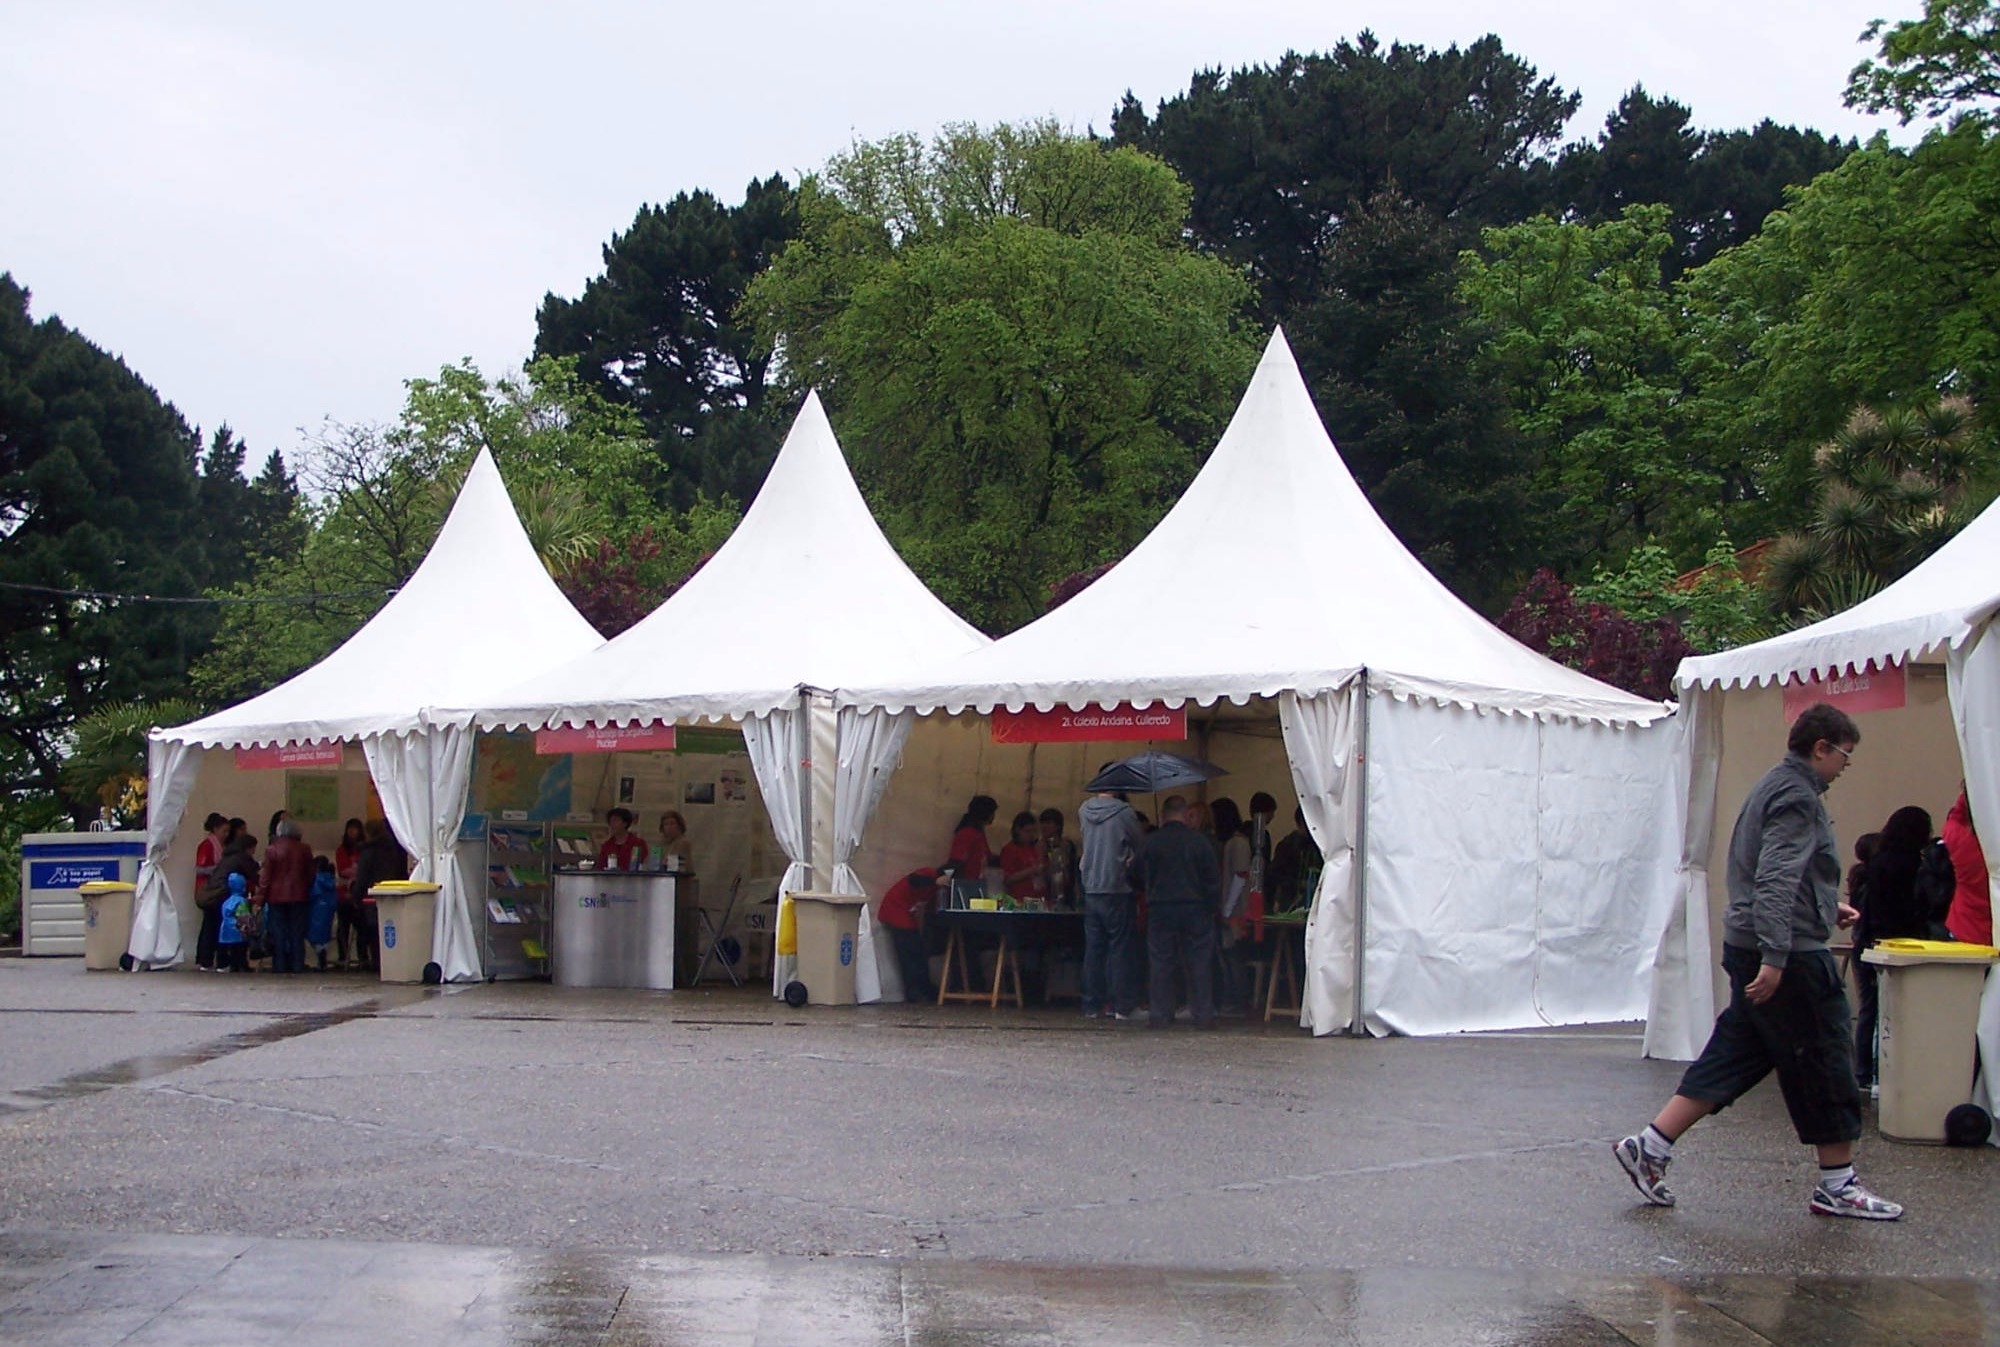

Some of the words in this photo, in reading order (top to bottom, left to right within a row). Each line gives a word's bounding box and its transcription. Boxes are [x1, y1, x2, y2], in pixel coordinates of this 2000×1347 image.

[1073, 716, 1099, 727] Colexio
[1135, 714, 1171, 726] Culleredo
[578, 896, 597, 909] CSN
[744, 913, 766, 929] CSN
